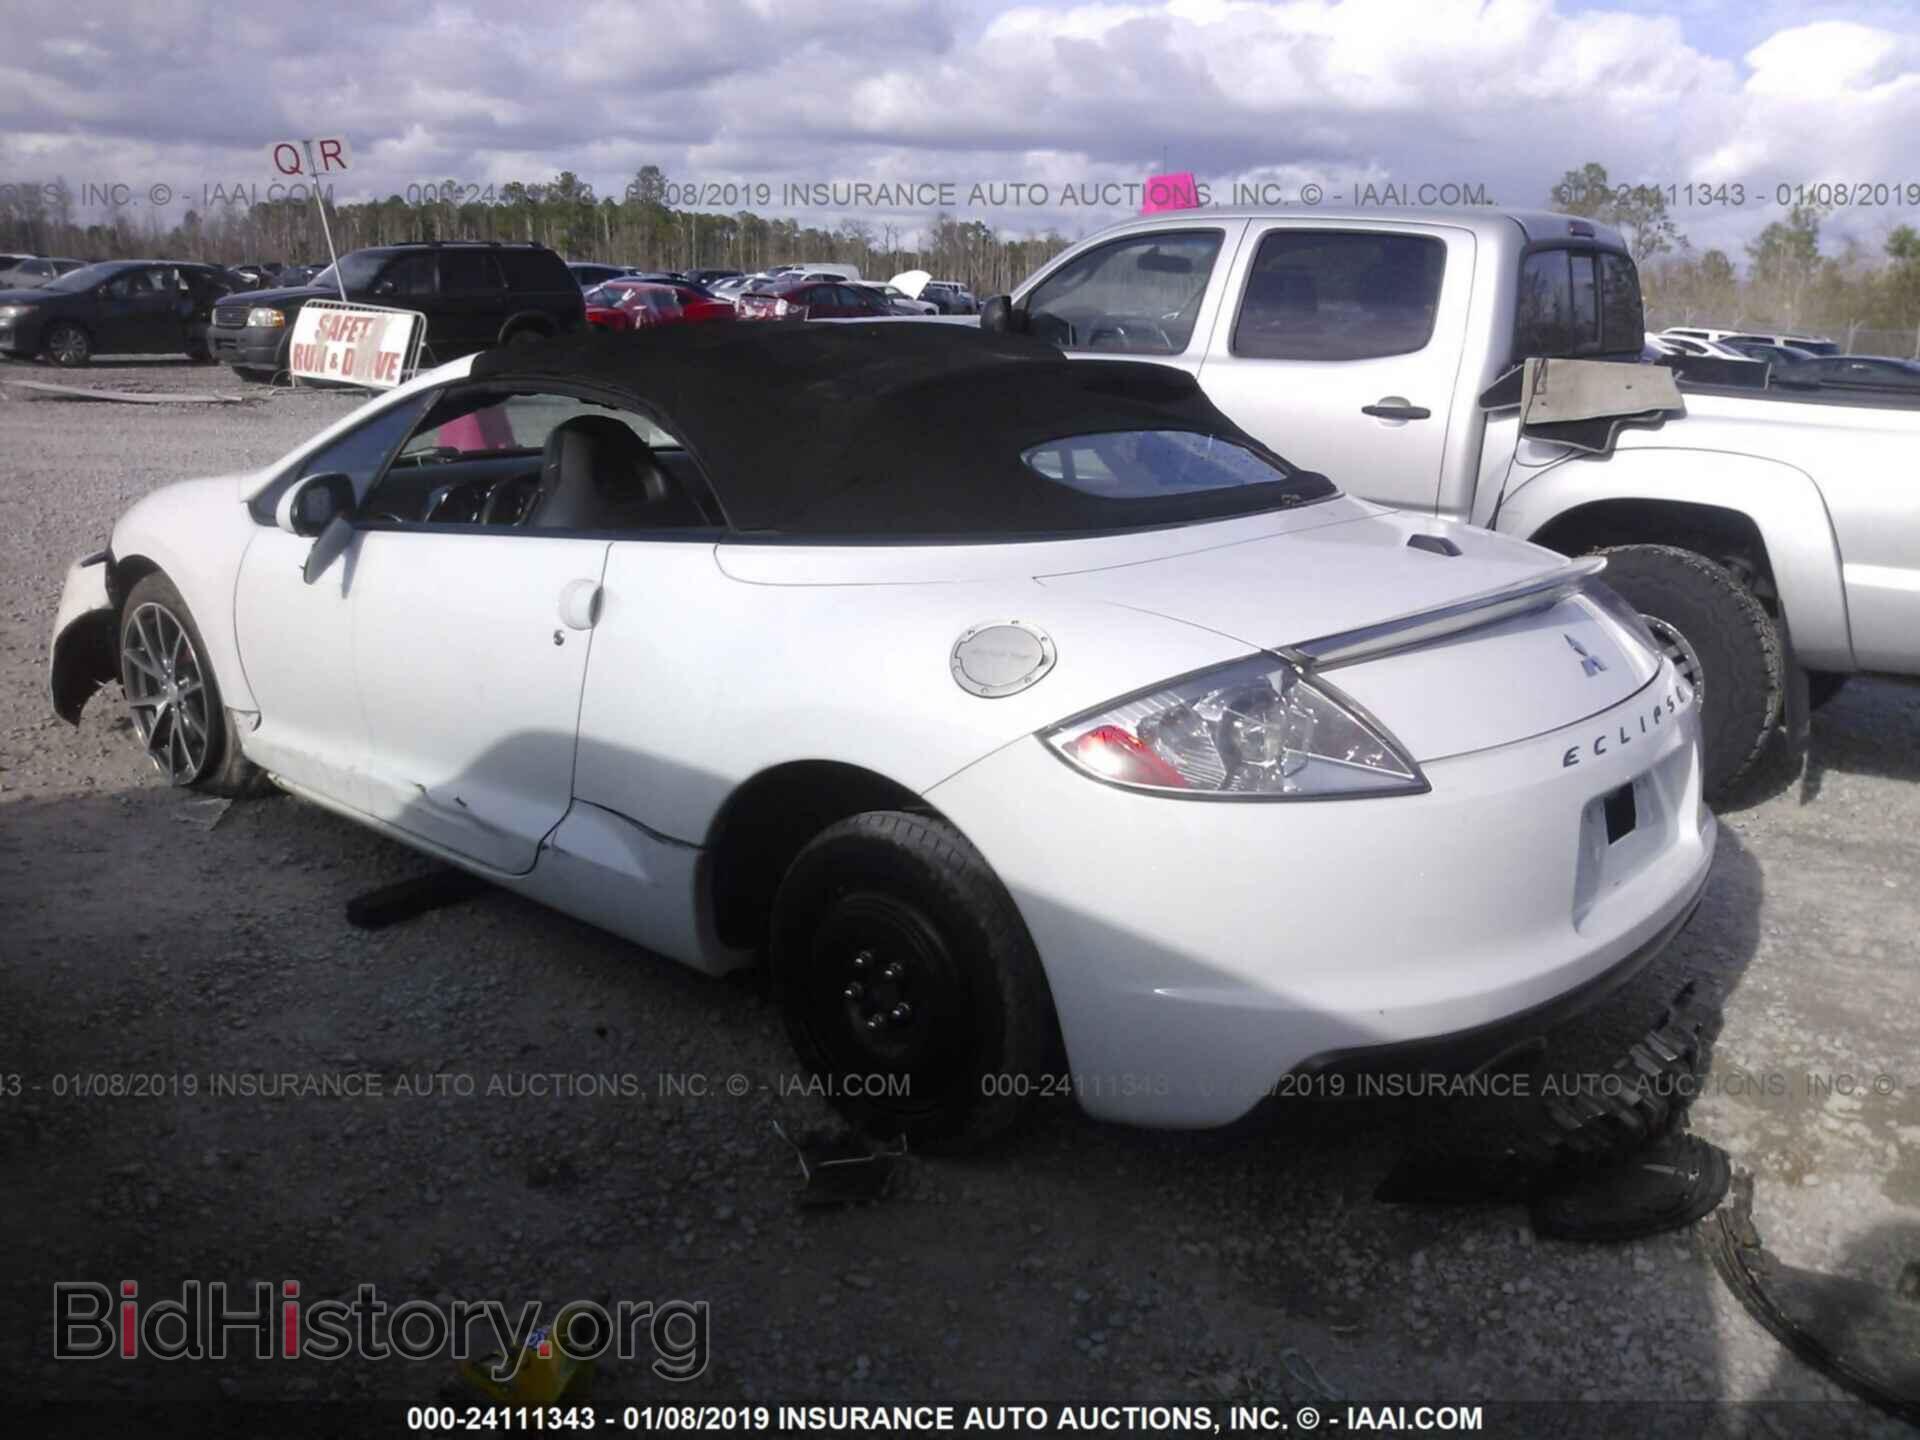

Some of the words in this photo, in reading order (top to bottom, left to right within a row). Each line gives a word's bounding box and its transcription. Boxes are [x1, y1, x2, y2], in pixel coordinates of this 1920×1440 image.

[274, 143, 303, 175] Q
[319, 139, 347, 171] R
[315, 313, 387, 343] SAFET
[341, 348, 400, 382] DVE
